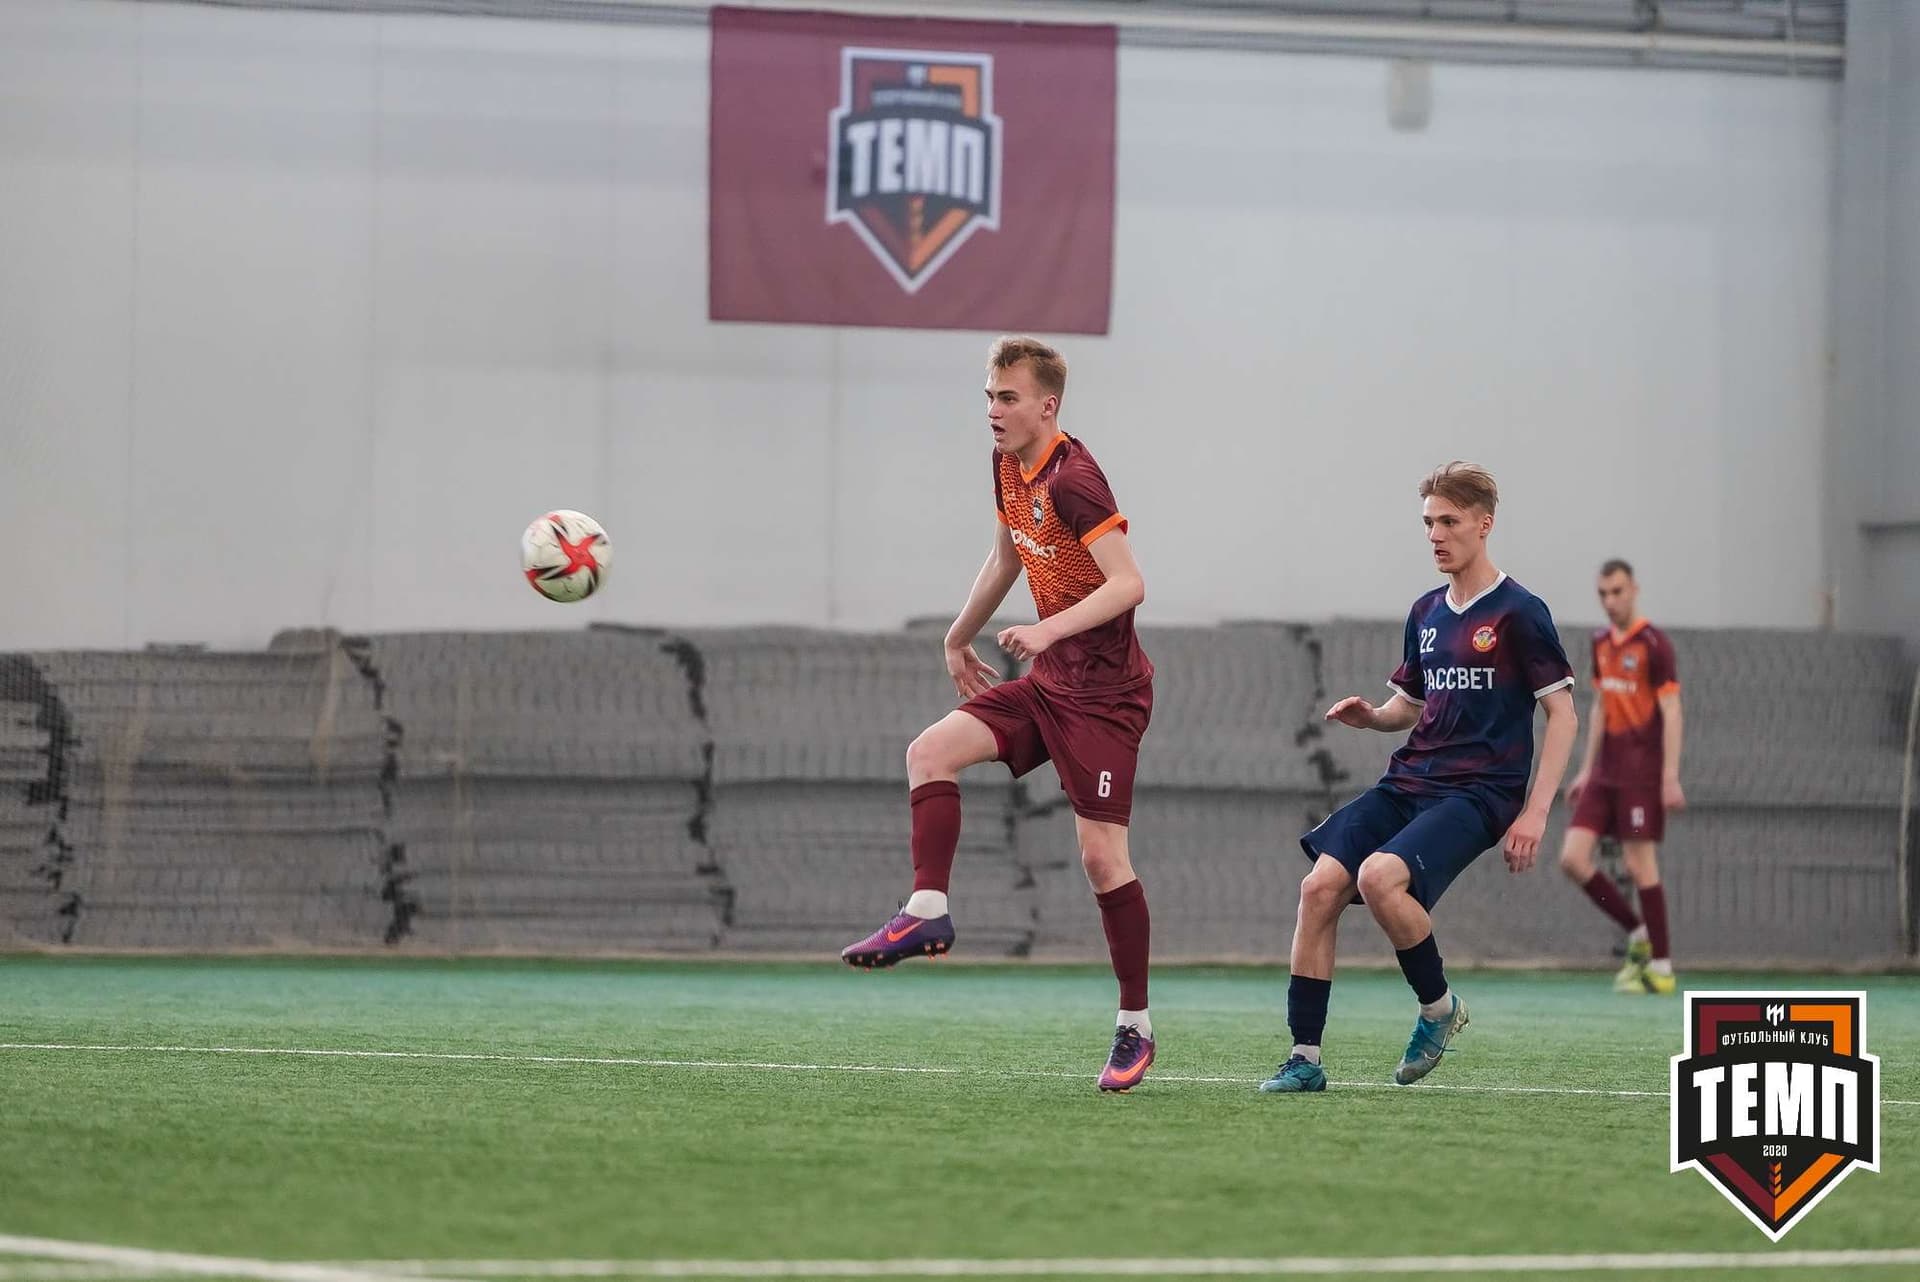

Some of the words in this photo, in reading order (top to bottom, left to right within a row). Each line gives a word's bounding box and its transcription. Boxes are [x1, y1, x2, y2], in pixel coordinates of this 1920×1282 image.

[847, 118, 985, 203] ТЕМП
[1419, 627, 1437, 654] 22
[1097, 770, 1112, 798] 6
